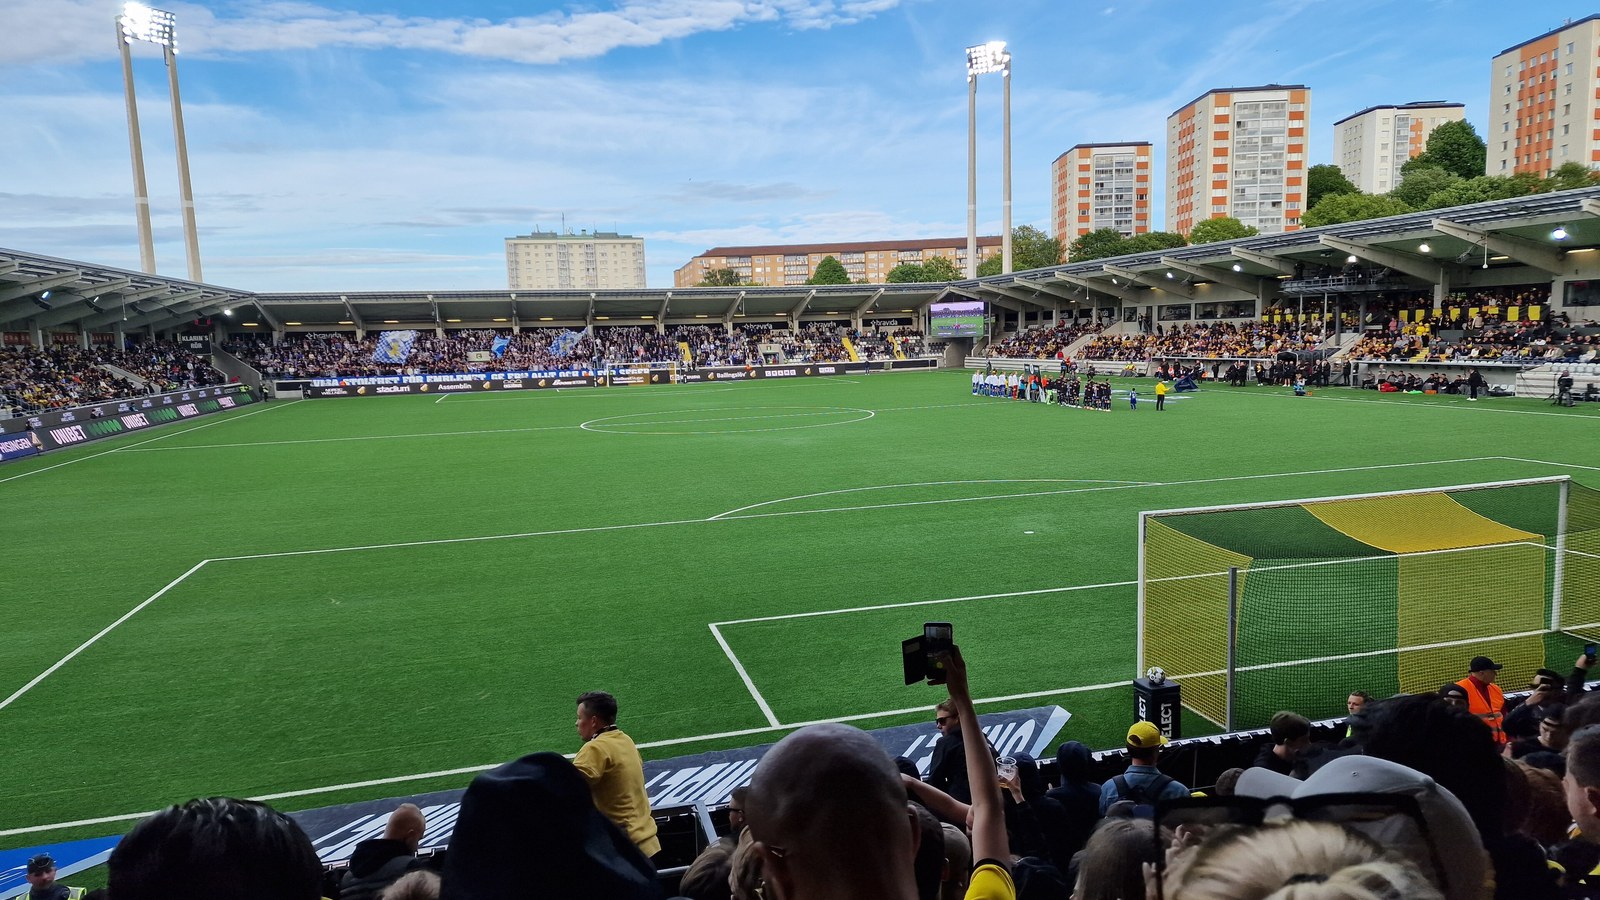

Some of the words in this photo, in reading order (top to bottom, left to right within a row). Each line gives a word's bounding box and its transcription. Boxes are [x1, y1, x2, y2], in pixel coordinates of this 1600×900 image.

[176, 403, 199, 417] UNIBET
[121, 412, 149, 428] UNIBET
[50, 425, 87, 444] UNIBET
[0, 438, 32, 453] HISINGEN
[1160, 703, 1172, 740] ELECT
